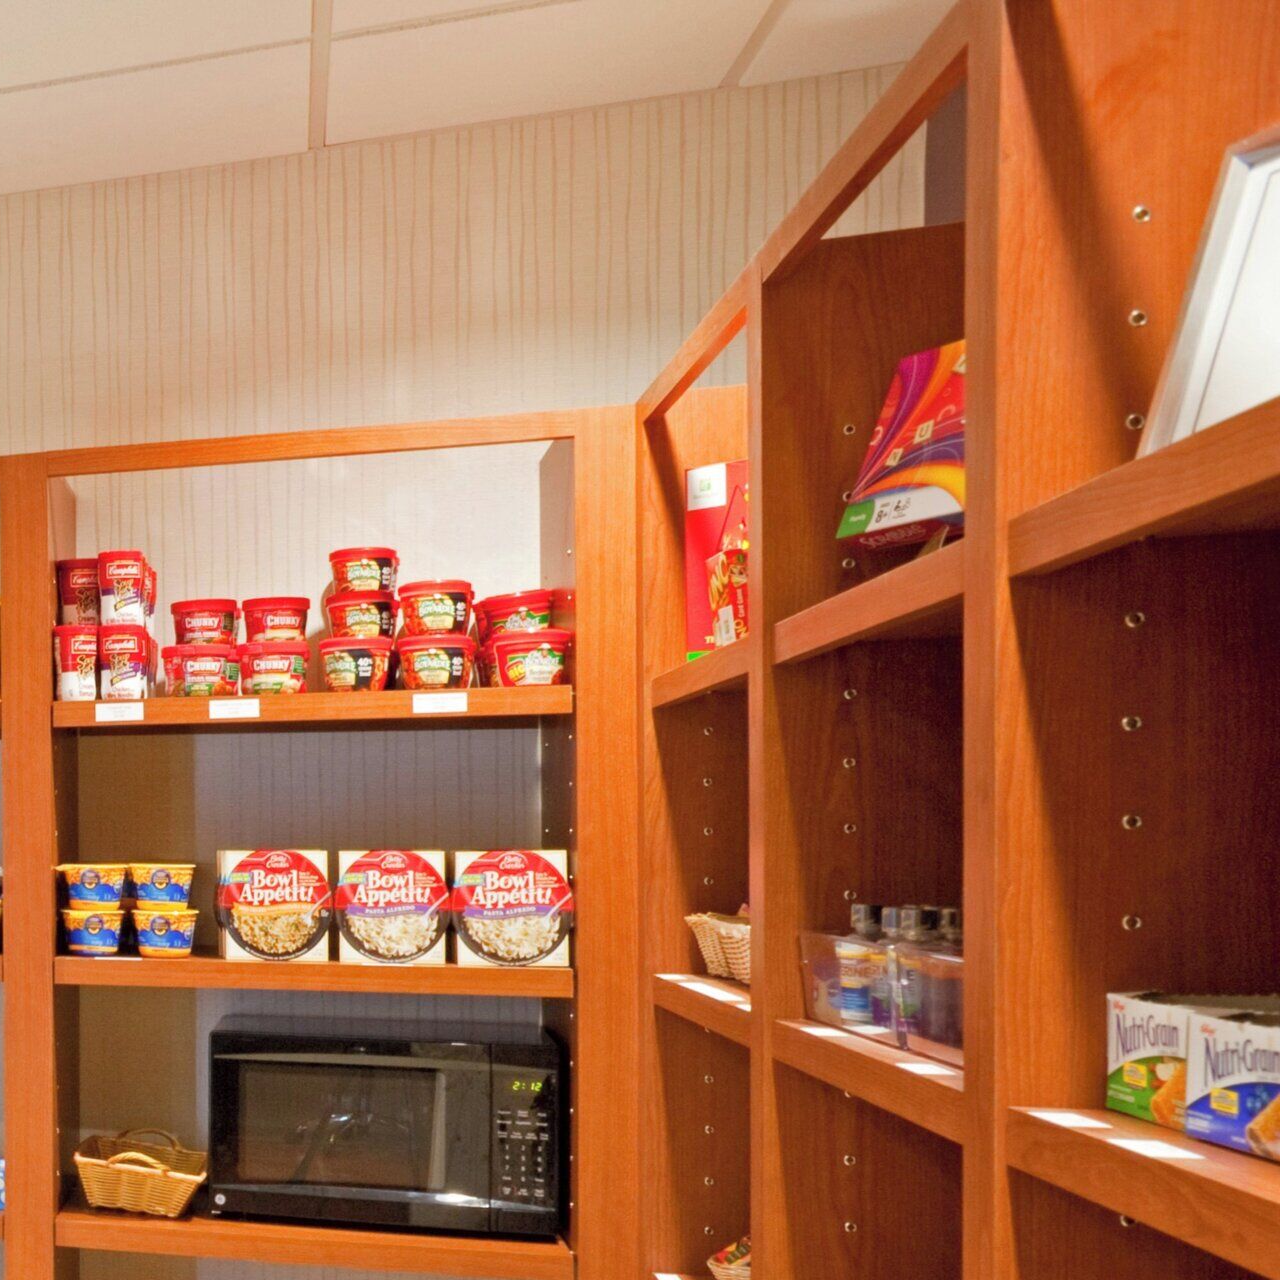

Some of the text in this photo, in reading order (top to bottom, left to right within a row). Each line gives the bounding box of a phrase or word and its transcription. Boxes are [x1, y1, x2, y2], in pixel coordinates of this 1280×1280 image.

[185, 617, 219, 628] CHUNKY
[266, 615, 301, 627] CHUNKY
[186, 661, 222, 673] CHUNKY
[253, 660, 289, 672] CHUNKY
[251, 870, 298, 890] Bowl
[367, 870, 414, 889] Bowl
[484, 870, 534, 890] Bowl
[386, 905, 416, 913] ALFREDO
[506, 906, 537, 915] ALFREDO
[512, 1081, 542, 1091] 2:12
